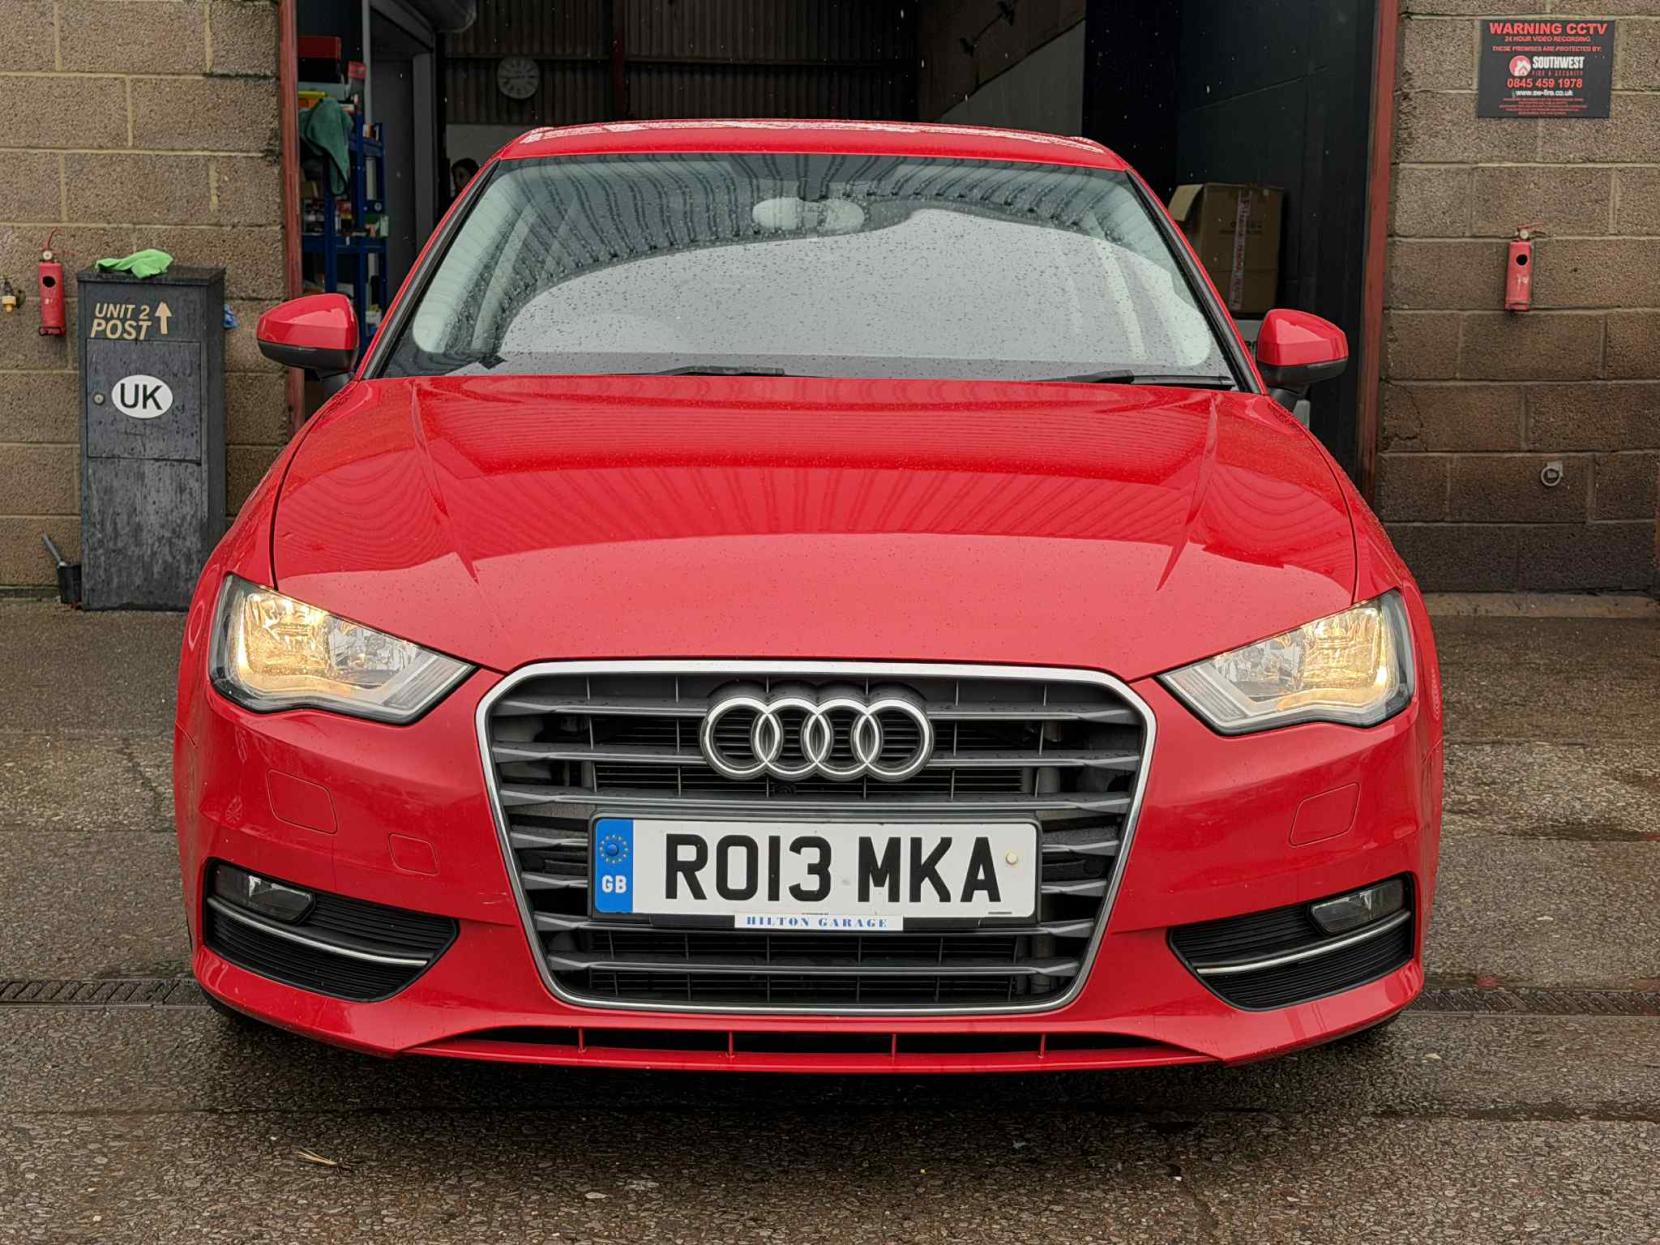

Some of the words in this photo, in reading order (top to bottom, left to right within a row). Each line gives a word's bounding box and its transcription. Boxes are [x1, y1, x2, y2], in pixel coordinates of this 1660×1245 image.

[1489, 23, 1562, 34] WARNING
[1566, 23, 1608, 34] CCTV
[1532, 56, 1585, 69] SOUTHWEST
[1507, 79, 1533, 88] 0845
[1535, 79, 1555, 88] 459
[1558, 79, 1583, 88] 1978
[95, 303, 136, 319] UNIT
[139, 305, 150, 320] 2
[90, 319, 152, 340] POST
[119, 383, 163, 410] UK
[857, 836, 1002, 903] MKA
[601, 875, 627, 894] GB
[746, 916, 810, 926] HILTON
[818, 917, 888, 928] GARAGE
